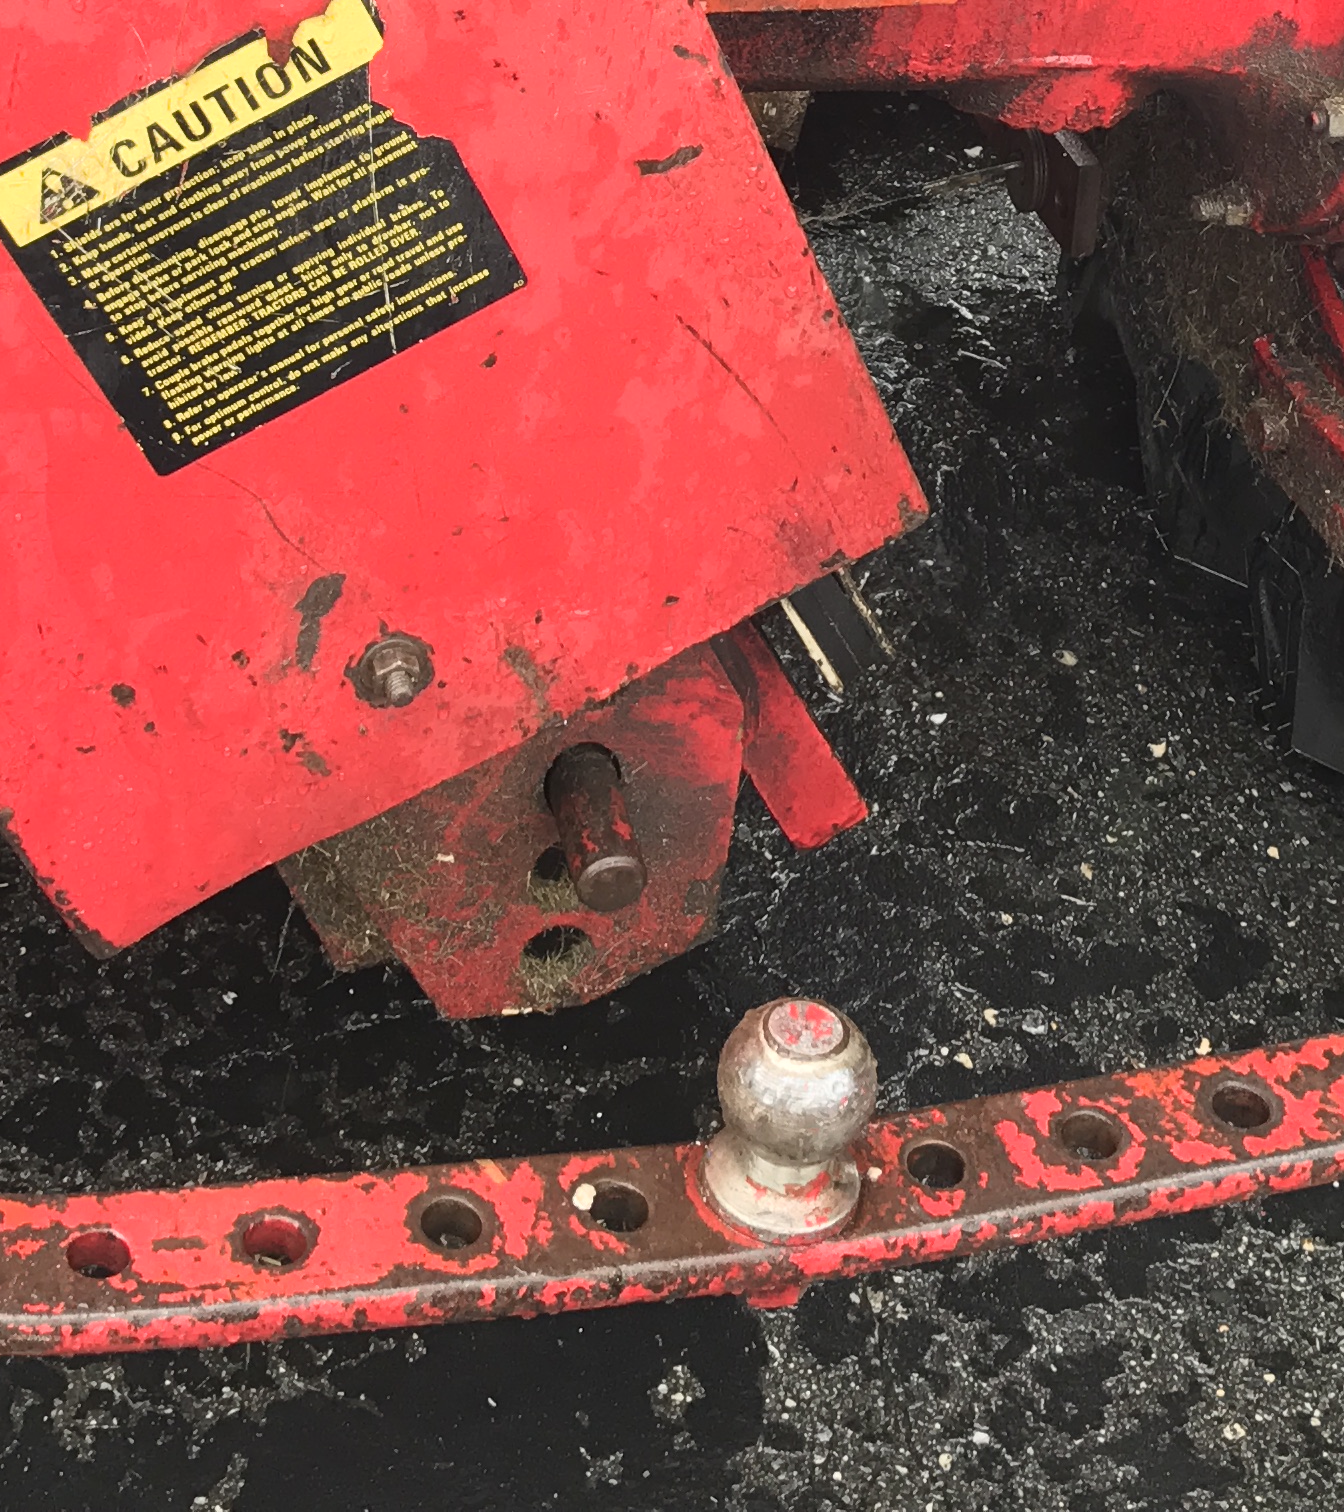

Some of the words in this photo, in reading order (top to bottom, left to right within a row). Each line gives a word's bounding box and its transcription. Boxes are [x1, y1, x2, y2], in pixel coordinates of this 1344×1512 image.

[110, 37, 333, 179] CAUTION
[49, 249, 62, 258] 1.
[62, 226, 102, 252] Shields
[102, 218, 121, 232] are
[120, 209, 137, 222] for
[138, 196, 162, 214] your
[245, 136, 273, 154] them
[272, 129, 286, 140] in
[286, 114, 317, 135] place.
[58, 262, 72, 273] 2.
[71, 248, 99, 266] Keep
[134, 216, 157, 232] feet
[157, 204, 178, 221] and
[178, 182, 222, 209] clothing
[221, 166, 249, 186] away
[249, 153, 276, 171] from
[274, 135, 308, 158] power
[309, 117, 342, 139] driven
[67, 275, 81, 286] 3.
[110, 240, 148, 264] certain
[146, 216, 192, 244] everyone
[190, 210, 203, 220] is
[202, 196, 228, 214] clear
[228, 187, 241, 200] of
[240, 162, 292, 194] machinery
[290, 143, 324, 167] before
[323, 123, 365, 149] starting
[103, 288, 140, 312] engage
[170, 262, 182, 276] or
[183, 252, 208, 271] park
[207, 239, 232, 256] lock
[232, 227, 252, 245] and
[251, 217, 275, 233] stop
[274, 199, 312, 221] engine.
[309, 183, 337, 201] Wait
[335, 175, 352, 188] for
[352, 165, 367, 180] all
[366, 139, 418, 174] movement
[104, 331, 118, 342] 5.
[117, 315, 145, 335] Keep
[146, 306, 163, 320] off
[218, 265, 238, 282] and
[239, 247, 277, 270] tractor
[277, 229, 311, 250] unless
[312, 215, 336, 232] seat
[337, 208, 349, 219] or
[351, 184, 394, 213] platform
[394, 177, 407, 188] is
[408, 166, 430, 183] pro-
[197, 218, 248, 249] disengage
[271, 187, 301, 209] lower
[303, 159, 357, 192] implement
[88, 278, 100, 289] or
[109, 312, 122, 322] to
[122, 297, 149, 315] stop
[146, 281, 180, 302] before
[180, 256, 228, 284] servicing
[226, 228, 282, 260] machinery.
[120, 354, 133, 364] 6.
[132, 330, 170, 358] Reduce
[172, 314, 203, 337] speed
[205, 301, 234, 319] when
[235, 280, 274, 303] turning
[276, 271, 288, 282] or
[291, 247, 335, 274] applying
[336, 217, 386, 250] individual
[388, 199, 427, 222] brakes.
[428, 189, 444, 199] To
[124, 324, 157, 345] vided.
[184, 292, 217, 313] others
[217, 281, 236, 295] off.
[140, 347, 169, 367] avoid
[171, 324, 213, 352] possible
[216, 297, 262, 327] rearward
[330, 250, 353, 267] only
[355, 242, 368, 253] to
[418, 205, 437, 220] not
[437, 199, 450, 209] to
[141, 386, 154, 396] 7.
[154, 367, 190, 389] Couple
[188, 352, 219, 371] brake
[218, 334, 253, 357] pedals
[252, 311, 295, 337] together
[294, 303, 311, 315] for
[310, 290, 335, 307] high
[335, 278, 358, 296] gear
[358, 271, 370, 282] or
[370, 256, 395, 275] road
[394, 240, 425, 262] travel
[425, 230, 445, 247] and
[444, 222, 463, 236] use
[146, 354, 184, 377] tractor.
[187, 317, 252, 355] REMEMBER:
[250, 286, 307, 320] TRACTORS
[307, 273, 331, 291] CAN
[331, 264, 348, 279] BE
[347, 243, 389, 270] ROLLED
[389, 227, 422, 248] OVER.
[160, 374, 203, 400] flashing
[244, 335, 276, 355] lights
[276, 327, 289, 339] at
[290, 317, 305, 331] all
[305, 304, 335, 323] times
[336, 296, 350, 307] on
[413, 244, 446, 266] unless
[446, 234, 467, 250] pro-
[174, 403, 202, 422] Refer
[202, 397, 216, 407] to
[268, 348, 305, 373] manual
[304, 340, 320, 354] for
[321, 316, 364, 347] personal
[364, 300, 395, 322] safety
[394, 270, 457, 305] instructions.
[166, 384, 204, 409] hibited
[202, 378, 217, 390] by
[183, 421, 202, 435] For
[203, 398, 247, 425] optimum
[286, 369, 301, 380] do
[301, 358, 320, 373] not
[320, 344, 348, 363] make
[349, 333, 368, 347] any
[424, 290, 447, 306] that
[190, 423, 222, 446] power
[223, 416, 235, 426] or
[236, 384, 300, 422] performance.
